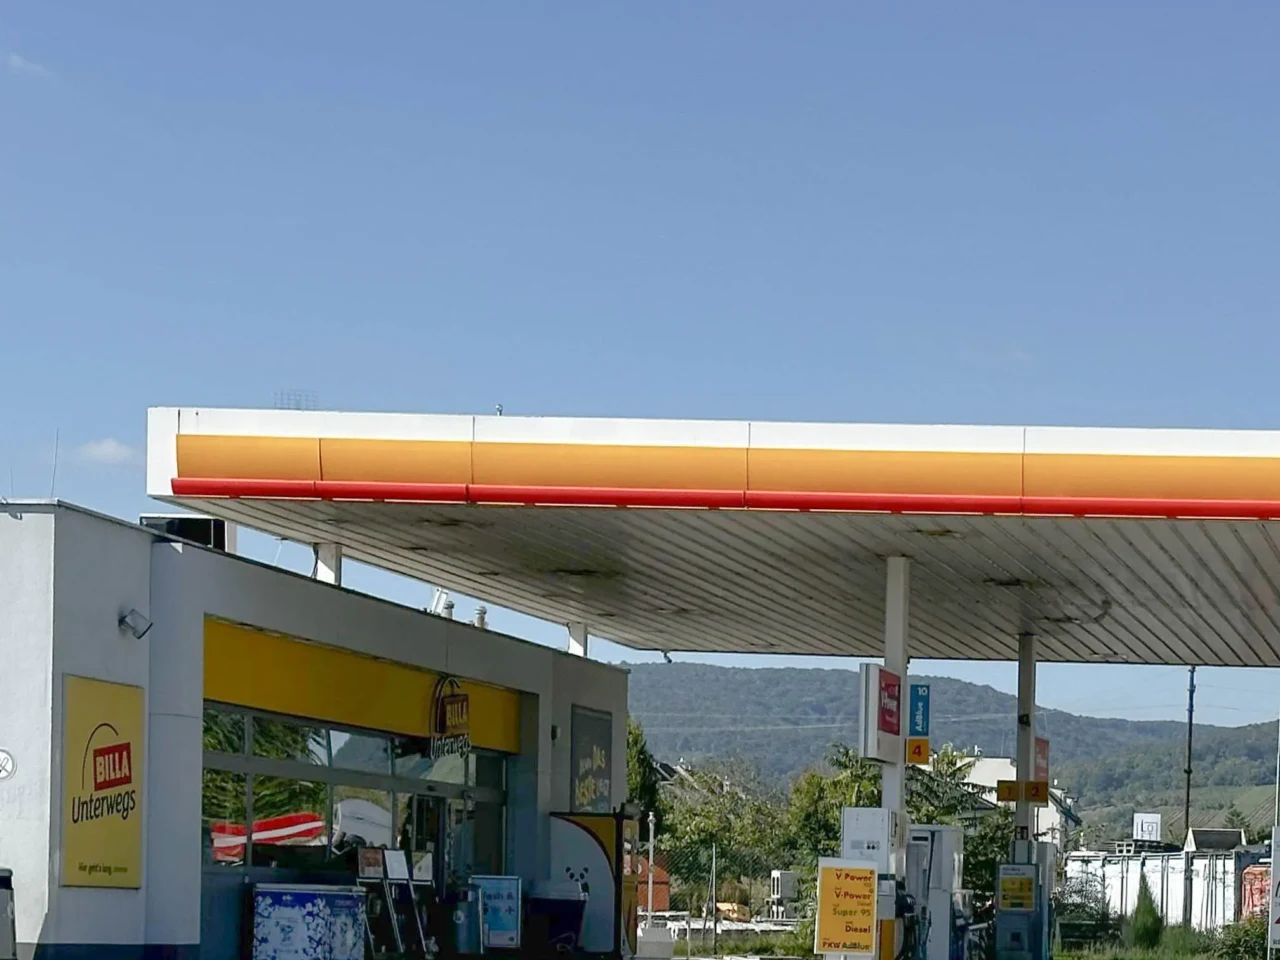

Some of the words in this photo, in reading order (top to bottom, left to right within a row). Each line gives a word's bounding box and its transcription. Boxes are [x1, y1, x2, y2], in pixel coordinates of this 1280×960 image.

[917, 687, 928, 696] 10
[446, 701, 468, 726] BILLA
[914, 701, 923, 732] AdBlue
[430, 734, 472, 759] Unterwegs
[912, 745, 922, 757] 4
[95, 751, 130, 783] BILLA
[1031, 785, 1039, 797] 2
[71, 789, 136, 823] Unterwegs
[835, 872, 842, 880] V
[845, 873, 872, 881] Power
[834, 890, 872, 900] V-Power
[832, 908, 857, 917] Super
[845, 925, 870, 933] Diesel
